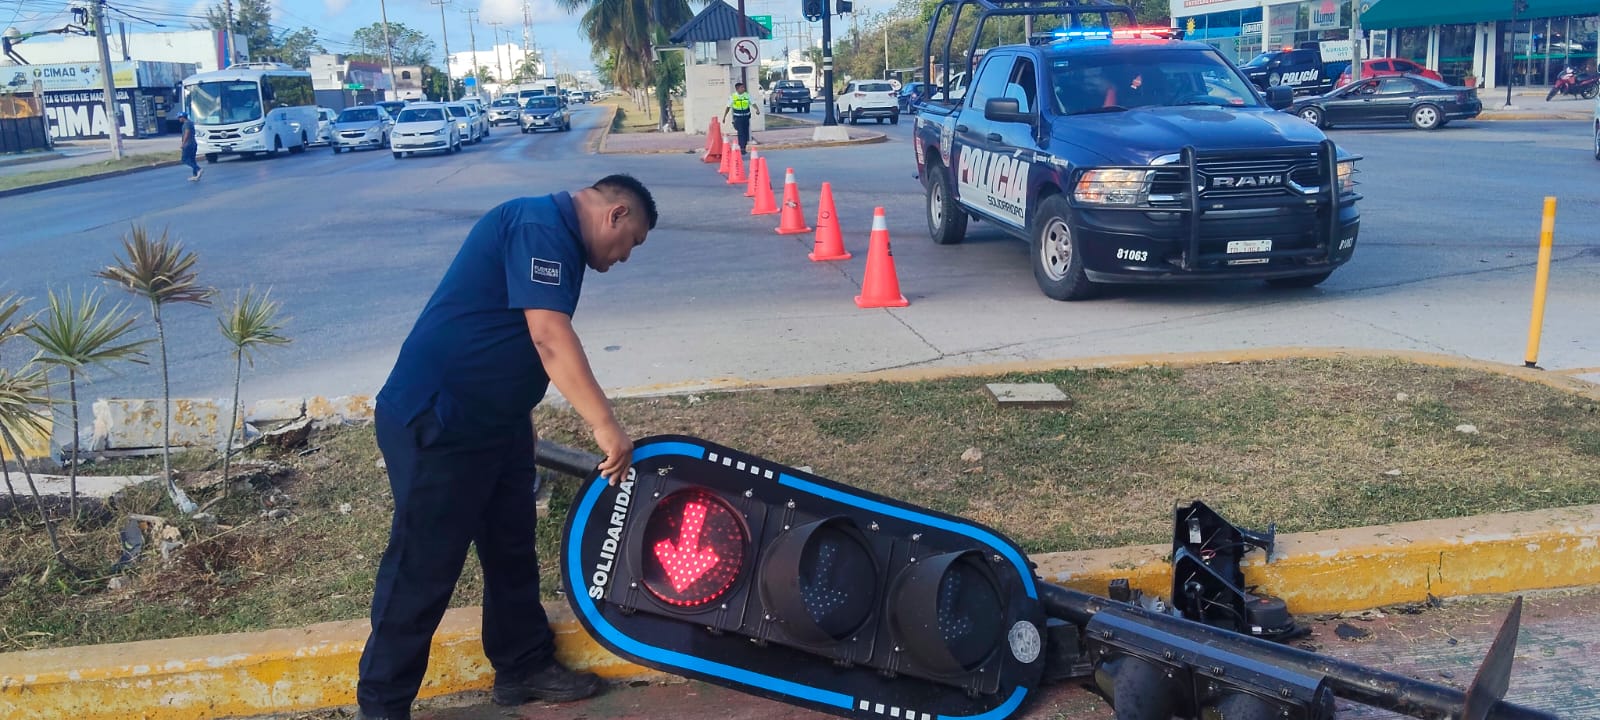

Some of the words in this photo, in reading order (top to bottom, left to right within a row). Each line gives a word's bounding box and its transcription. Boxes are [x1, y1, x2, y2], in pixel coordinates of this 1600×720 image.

[44, 67, 76, 77] CIMAQ
[1281, 69, 1319, 83] POLICÍA
[958, 145, 1030, 204] POLICÍA
[1212, 175, 1282, 187] RAM
[1116, 248, 1148, 262] 81063
[588, 466, 637, 601] SOLIDARIDAD
